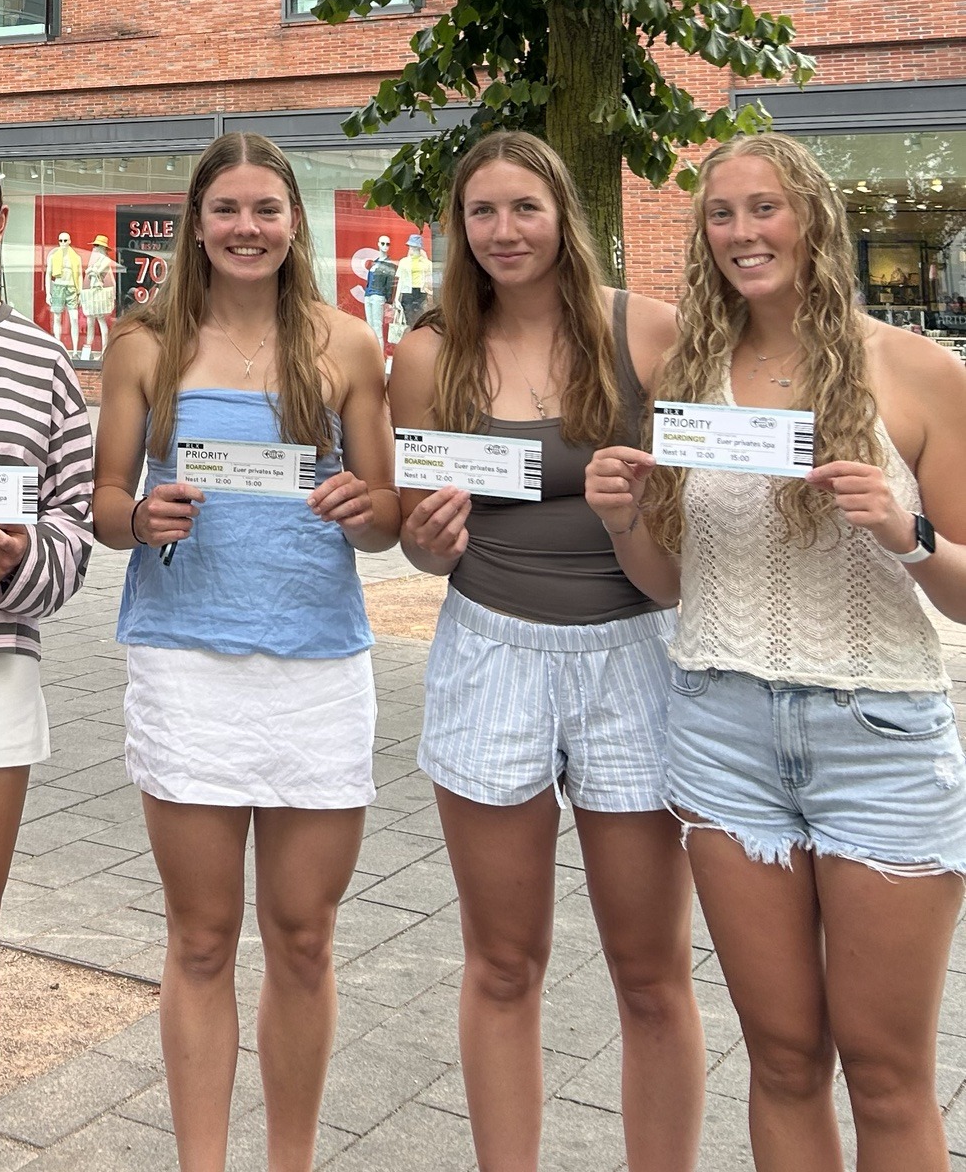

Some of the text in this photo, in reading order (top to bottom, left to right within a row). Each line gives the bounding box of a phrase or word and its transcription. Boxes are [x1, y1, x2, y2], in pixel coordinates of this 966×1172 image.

[129, 220, 174, 238] SALE
[134, 256, 168, 284] 70
[663, 417, 712, 430] PRIORITY
[404, 443, 449, 454] PRIORITY
[733, 439, 761, 448] privates
[762, 441, 775, 450] Spa
[185, 450, 229, 461] PRIORITY
[272, 469, 284, 477] Spa
[470, 464, 494, 473] privates
